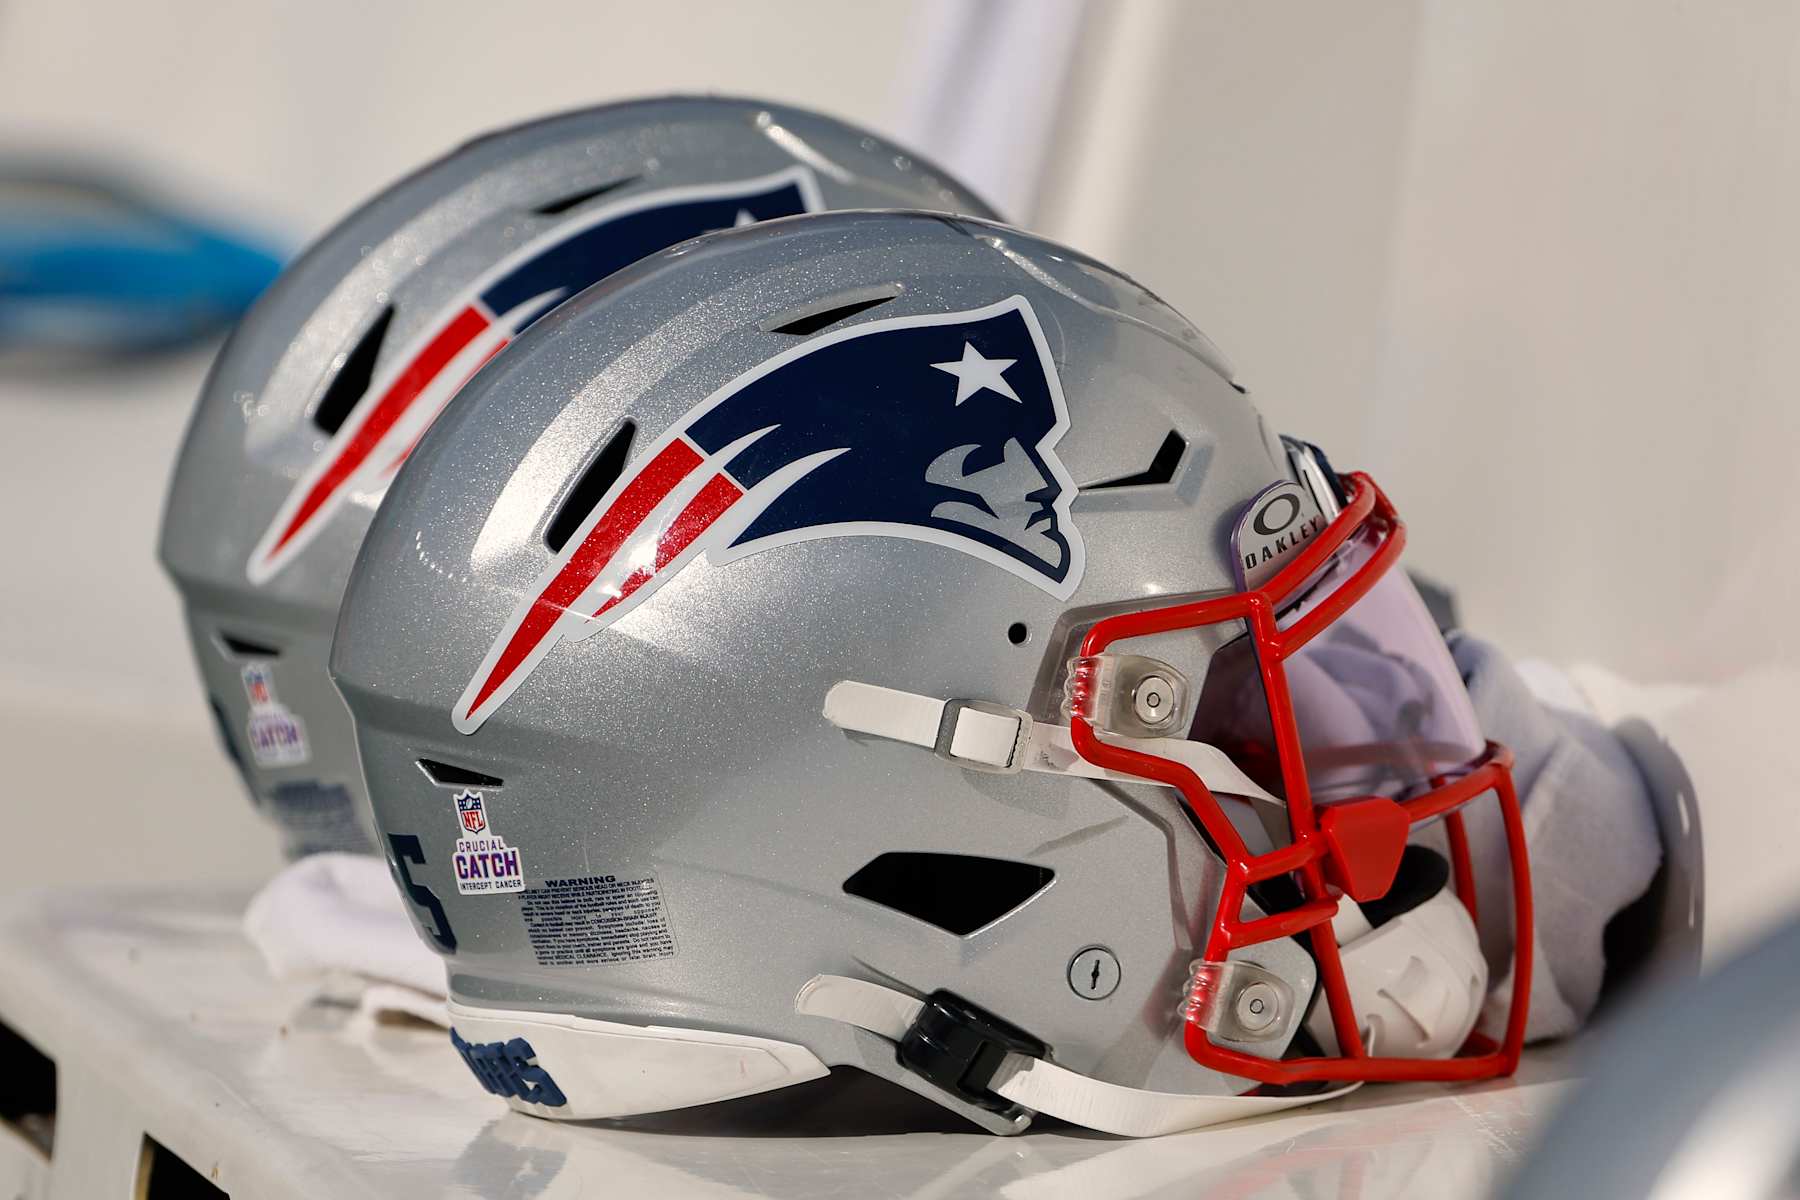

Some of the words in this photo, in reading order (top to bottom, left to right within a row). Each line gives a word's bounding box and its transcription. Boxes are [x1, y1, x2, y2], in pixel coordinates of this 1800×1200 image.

[1245, 518, 1318, 570] OAKLEY
[463, 811, 484, 829] NFL
[459, 840, 504, 852] CRUCIAL
[456, 851, 519, 879] CATCH
[460, 881, 492, 890] INTERCEPT
[496, 879, 521, 888] CANCER
[545, 875, 616, 888] WARNING
[387, 832, 457, 954] 5
